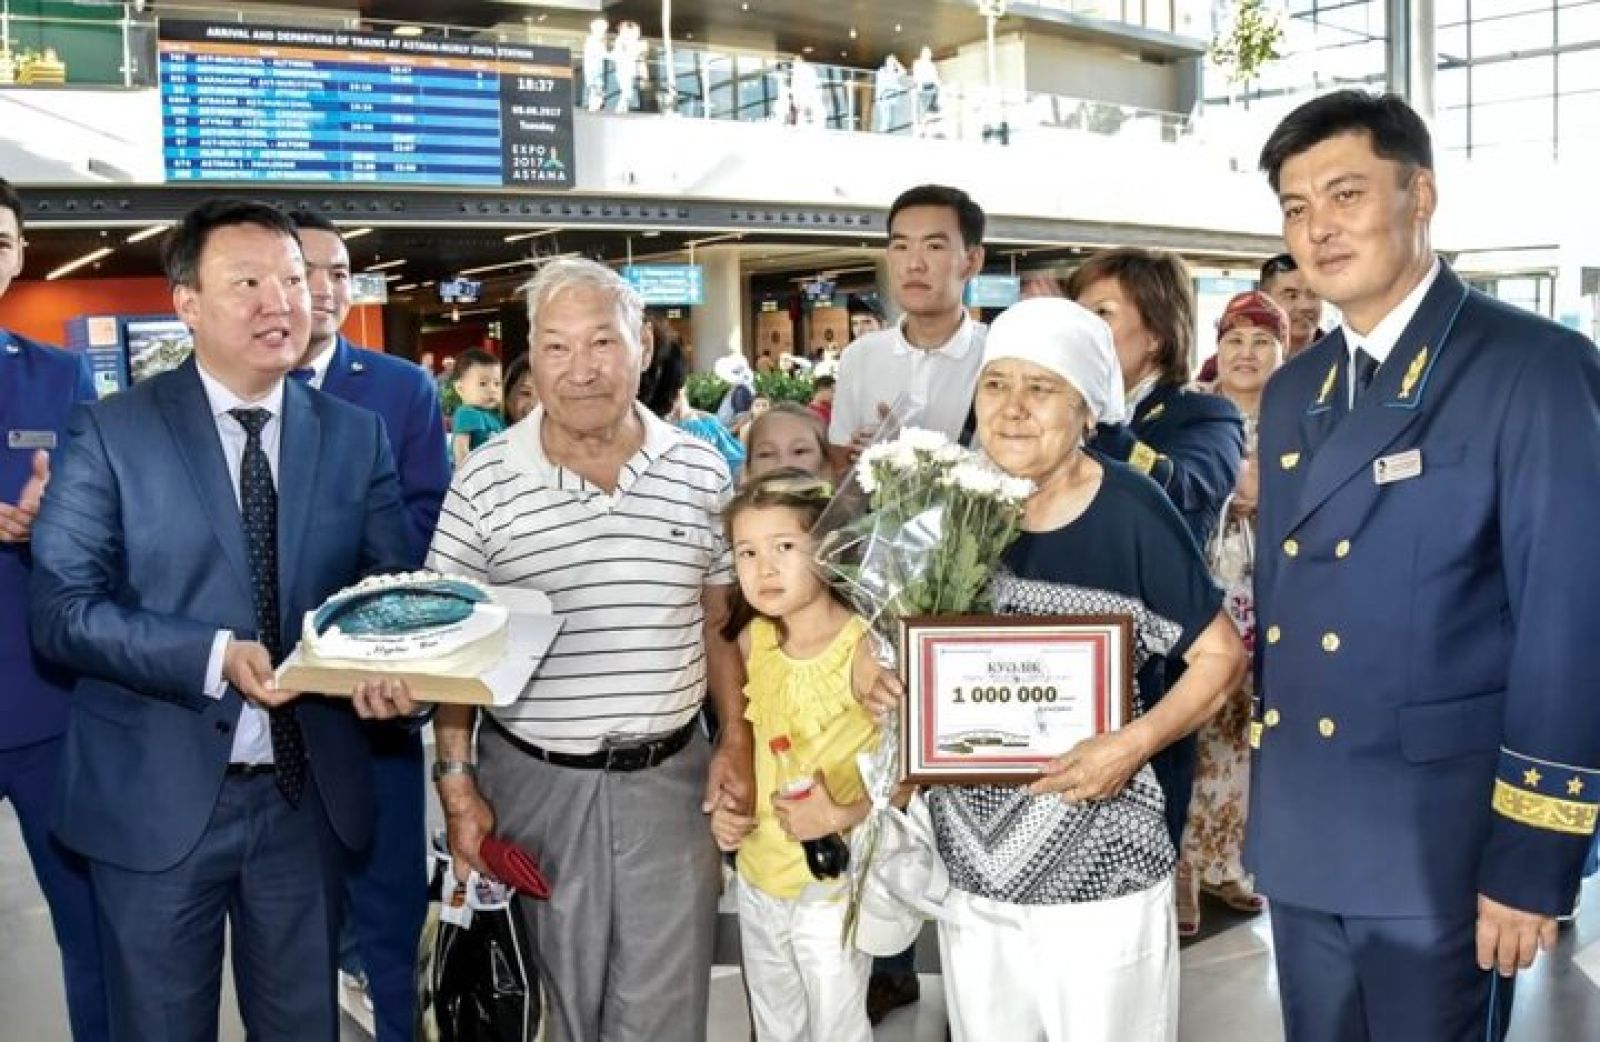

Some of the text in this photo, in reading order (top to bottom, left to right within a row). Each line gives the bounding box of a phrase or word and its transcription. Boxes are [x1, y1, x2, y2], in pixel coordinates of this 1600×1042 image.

[206, 26, 250, 39] ARRIVAL
[252, 29, 275, 41] AND
[277, 30, 334, 44] DEPARTURE
[335, 35, 348, 45] OF
[352, 36, 386, 48] TRAINS
[388, 39, 401, 49] AT
[497, 48, 534, 59] STATION
[517, 78, 554, 92] 18:37
[519, 120, 556, 133] Tuesday
[512, 144, 545, 155] EXPO
[512, 157, 543, 168] 2017
[512, 170, 566, 181] ASTANA
[952, 686, 1057, 703] 1 000 000
